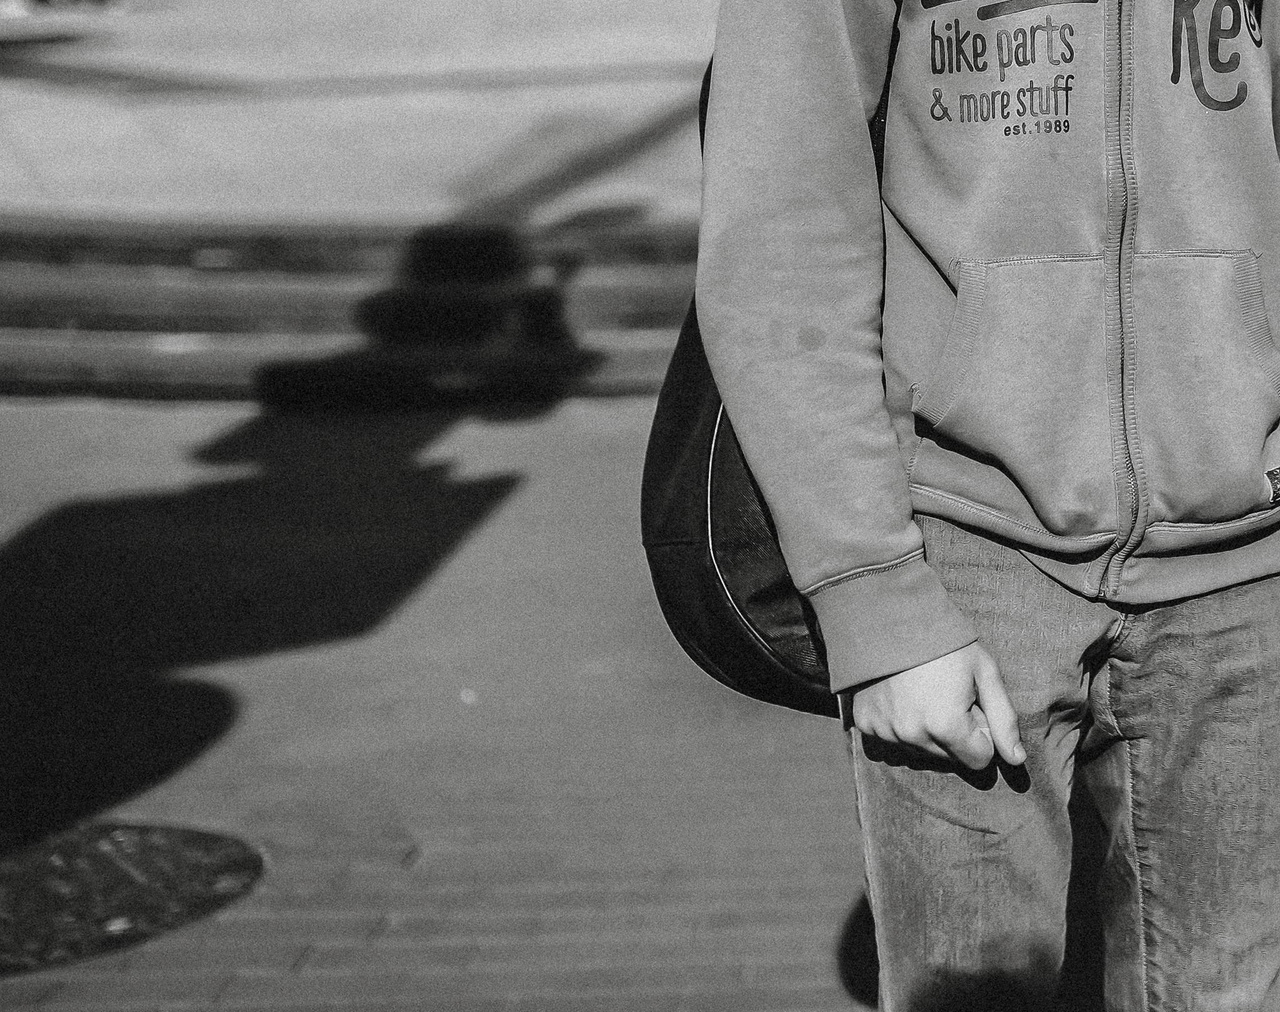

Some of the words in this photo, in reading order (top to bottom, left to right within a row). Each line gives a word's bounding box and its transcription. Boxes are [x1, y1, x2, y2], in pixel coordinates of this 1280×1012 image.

[930, 18, 988, 75] bike
[996, 15, 1075, 82] parts
[930, 87, 953, 122] &
[959, 90, 1011, 123] more
[1016, 74, 1075, 117] stuff
[1003, 119, 1070, 137] est.1989
